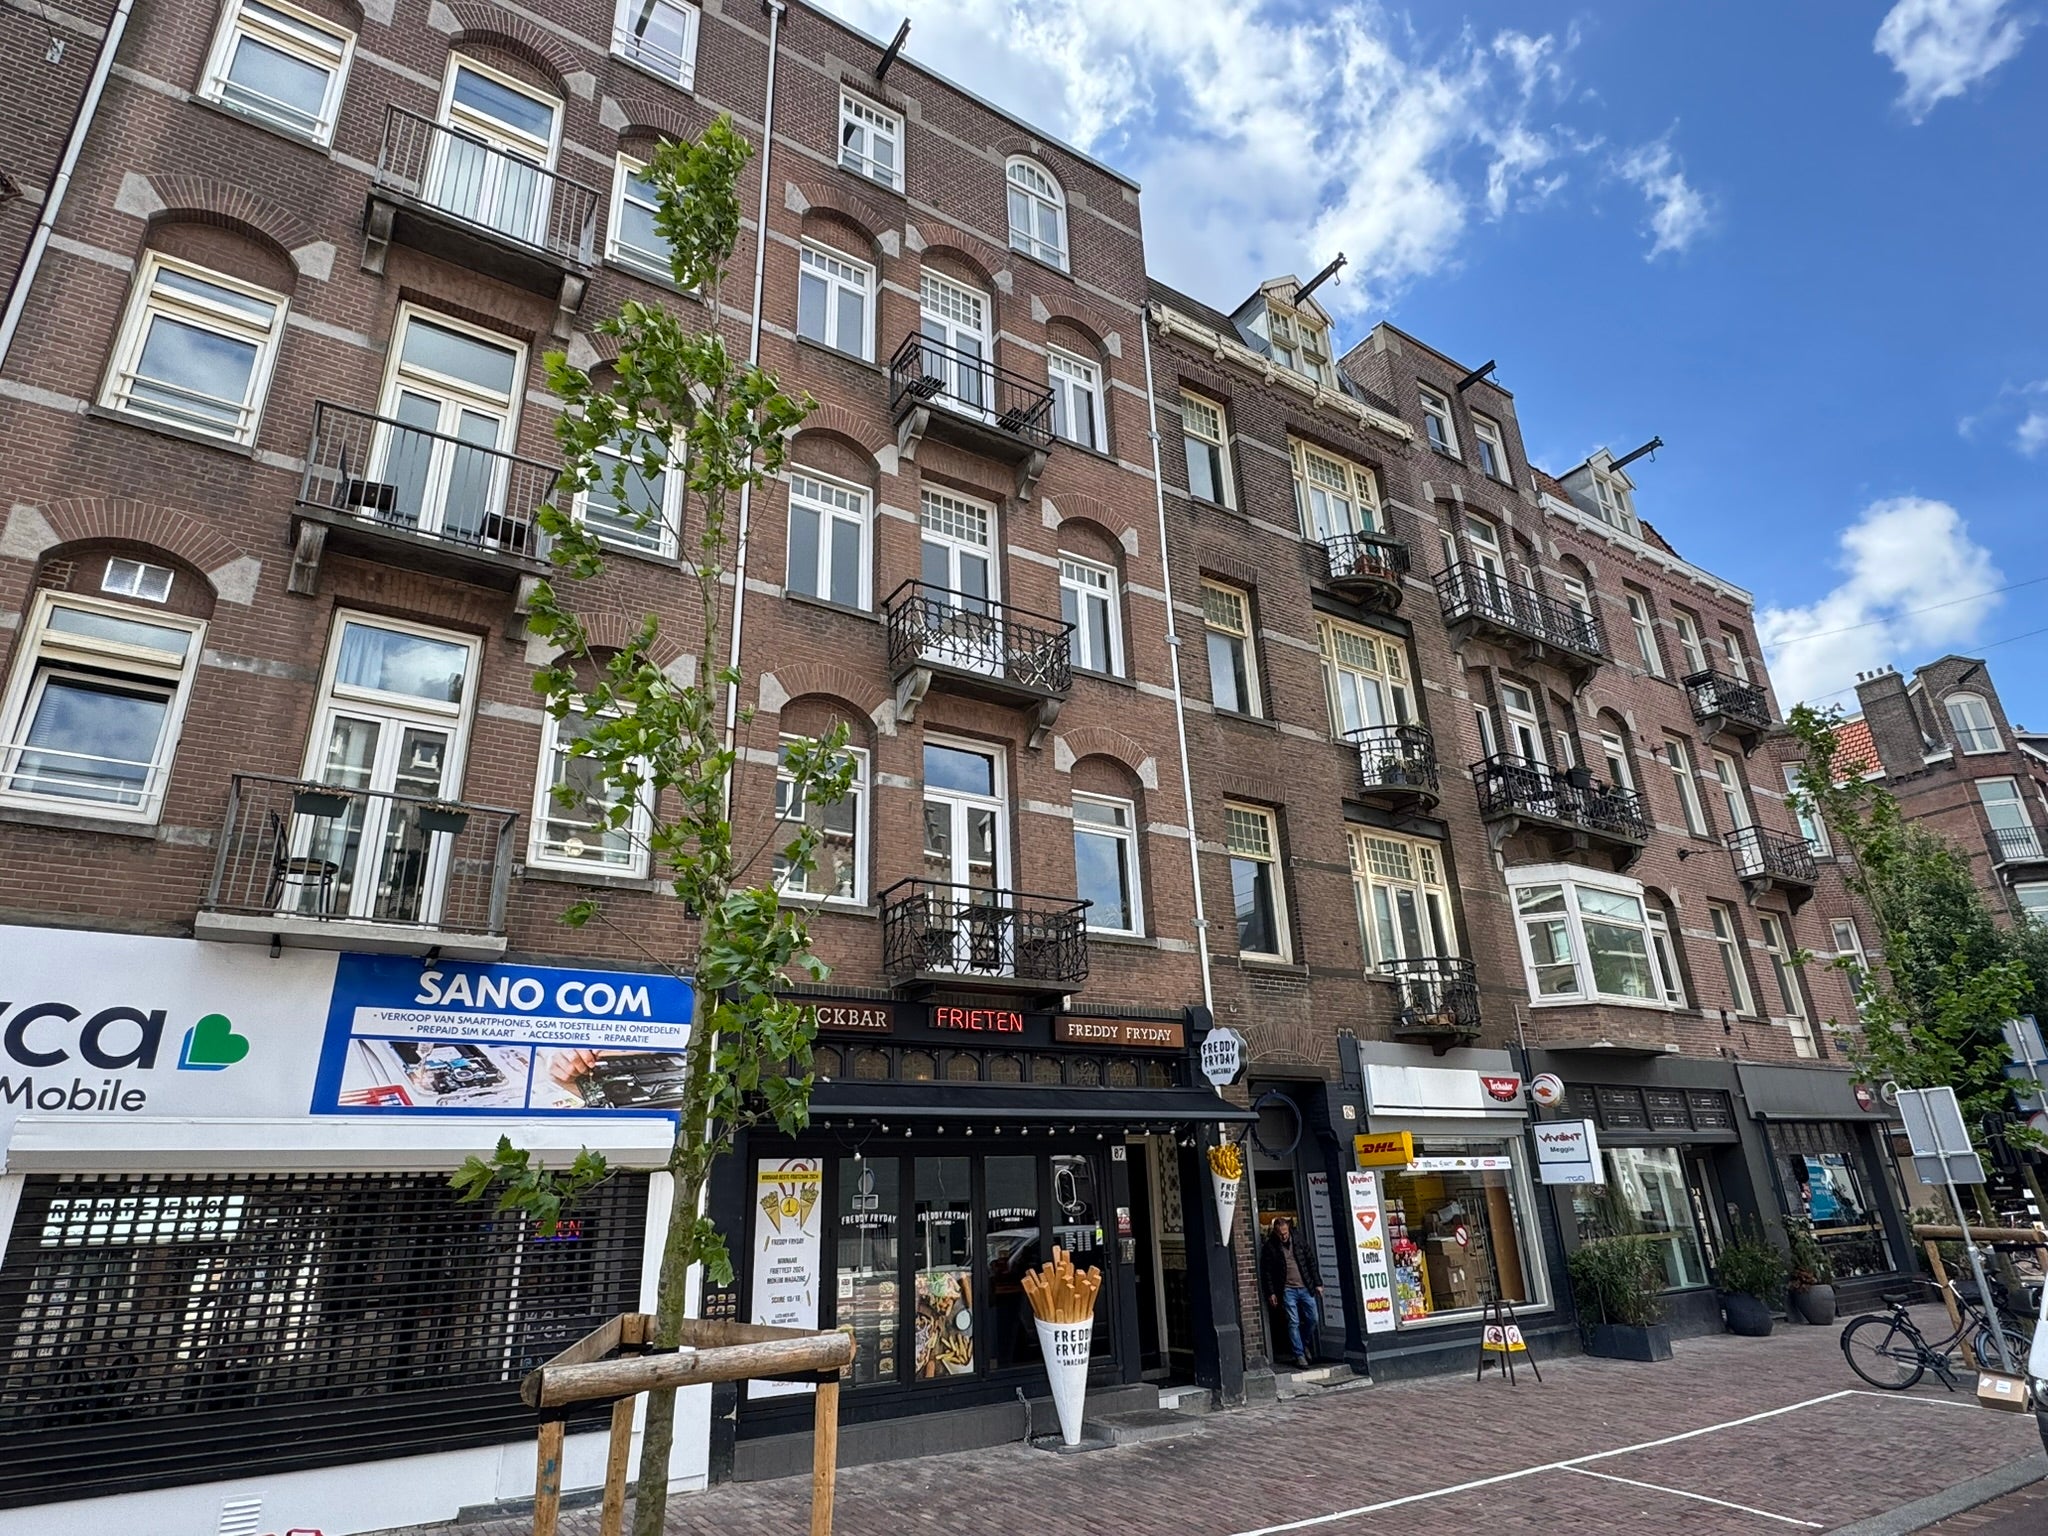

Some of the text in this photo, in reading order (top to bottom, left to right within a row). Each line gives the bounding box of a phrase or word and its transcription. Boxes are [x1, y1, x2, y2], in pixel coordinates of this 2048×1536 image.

[414, 970, 652, 1017] SANO COM
[380, 1011, 431, 1023] VERKOOP
[434, 1014, 456, 1024] VAN
[535, 1019, 557, 1029] GSM
[559, 1020, 613, 1032] TOESTELLEN
[615, 1023, 628, 1032] EN
[629, 1023, 681, 1035] ONDEDELEN
[937, 1007, 1023, 1032] FRIETEN
[0, 1002, 168, 1070] ca
[416, 1024, 649, 1044] PREPAID SIM KAART ACCESSOIRES REPARATIE
[1068, 1023, 1173, 1041] FREDDY FRYDAY
[1202, 1040, 1236, 1056] FREDDY
[1204, 1053, 1236, 1068] FRYDAY
[0, 1076, 147, 1112] Mobile
[1113, 1147, 1124, 1159] 87
[1362, 1141, 1397, 1154] DHL
[1221, 1182, 1236, 1191] FRE
[1220, 1191, 1235, 1199] FRY
[841, 1213, 897, 1226] FREDDY FRYDAY
[917, 1211, 970, 1222] FREDDY FRYDAY
[988, 1208, 1037, 1219] FREDDY FRYDAY
[1362, 1272, 1388, 1290] TOTO
